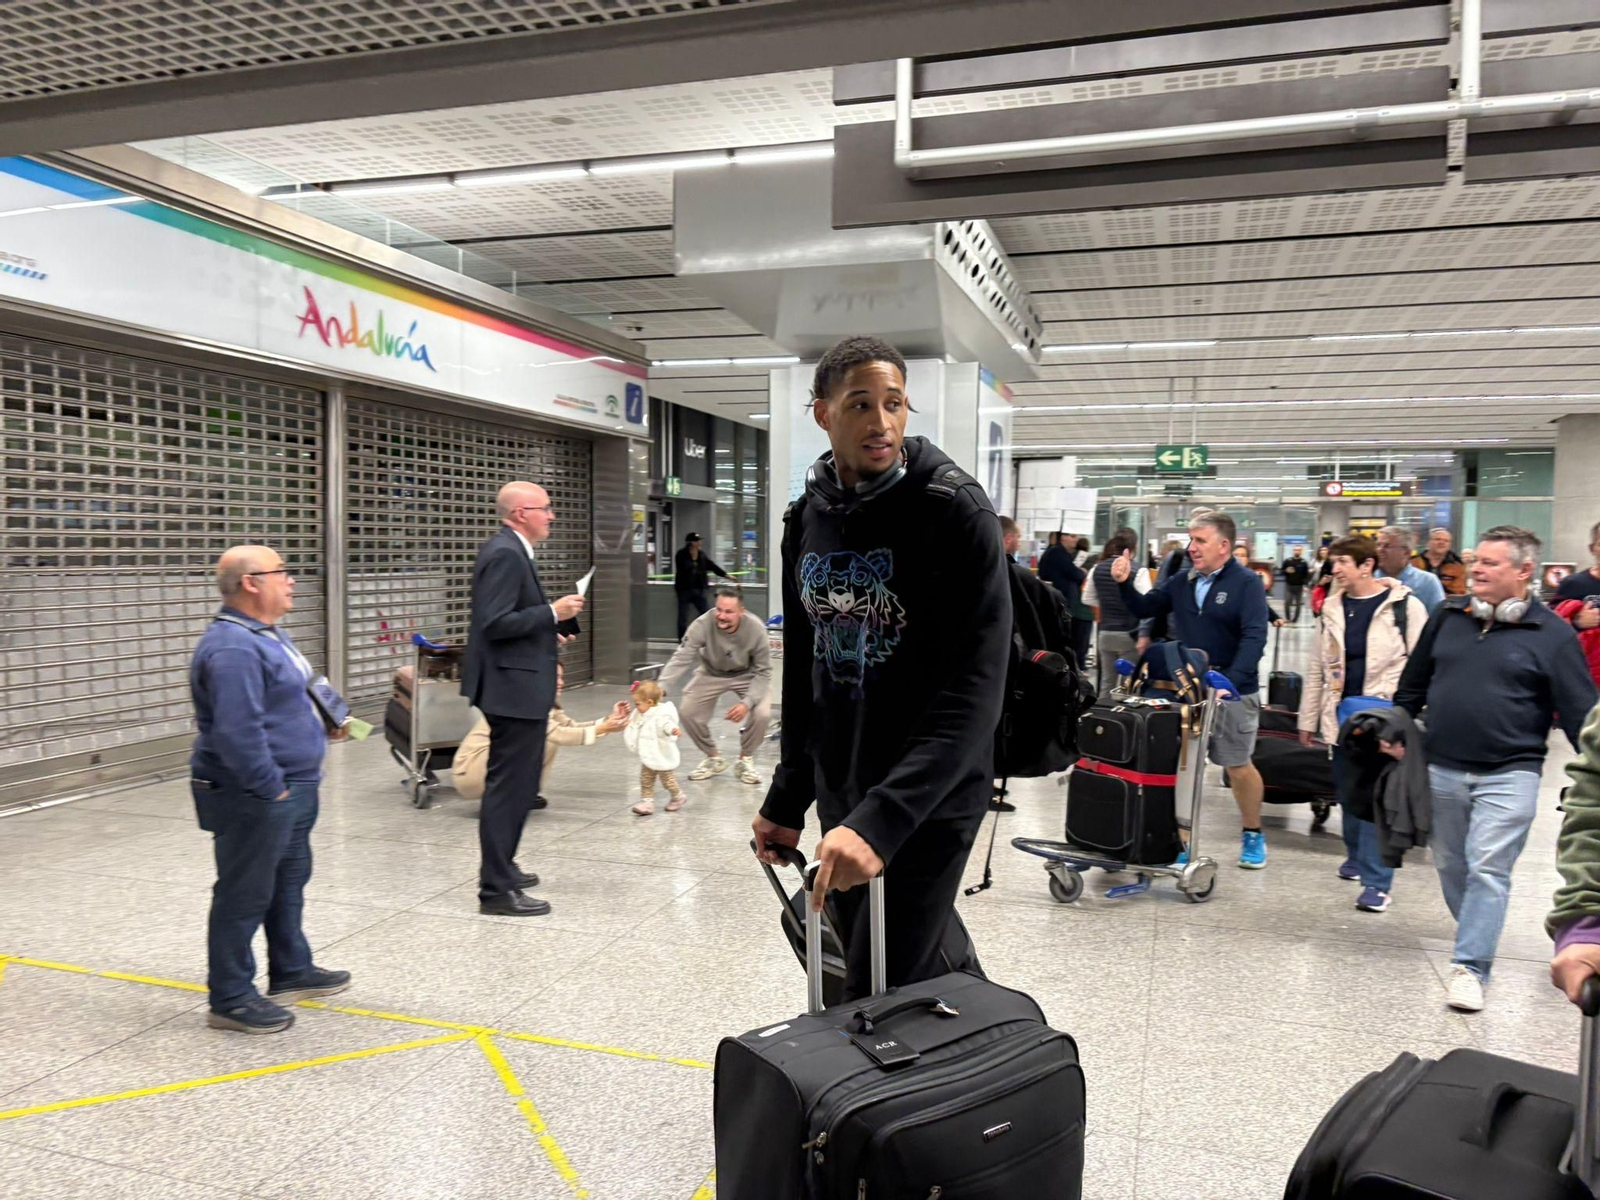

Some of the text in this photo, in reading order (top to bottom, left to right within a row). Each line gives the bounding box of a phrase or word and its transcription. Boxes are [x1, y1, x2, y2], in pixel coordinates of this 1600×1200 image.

[296, 285, 437, 373] Andalucía
[684, 437, 706, 458] Uber
[875, 1040, 897, 1050] ACR
